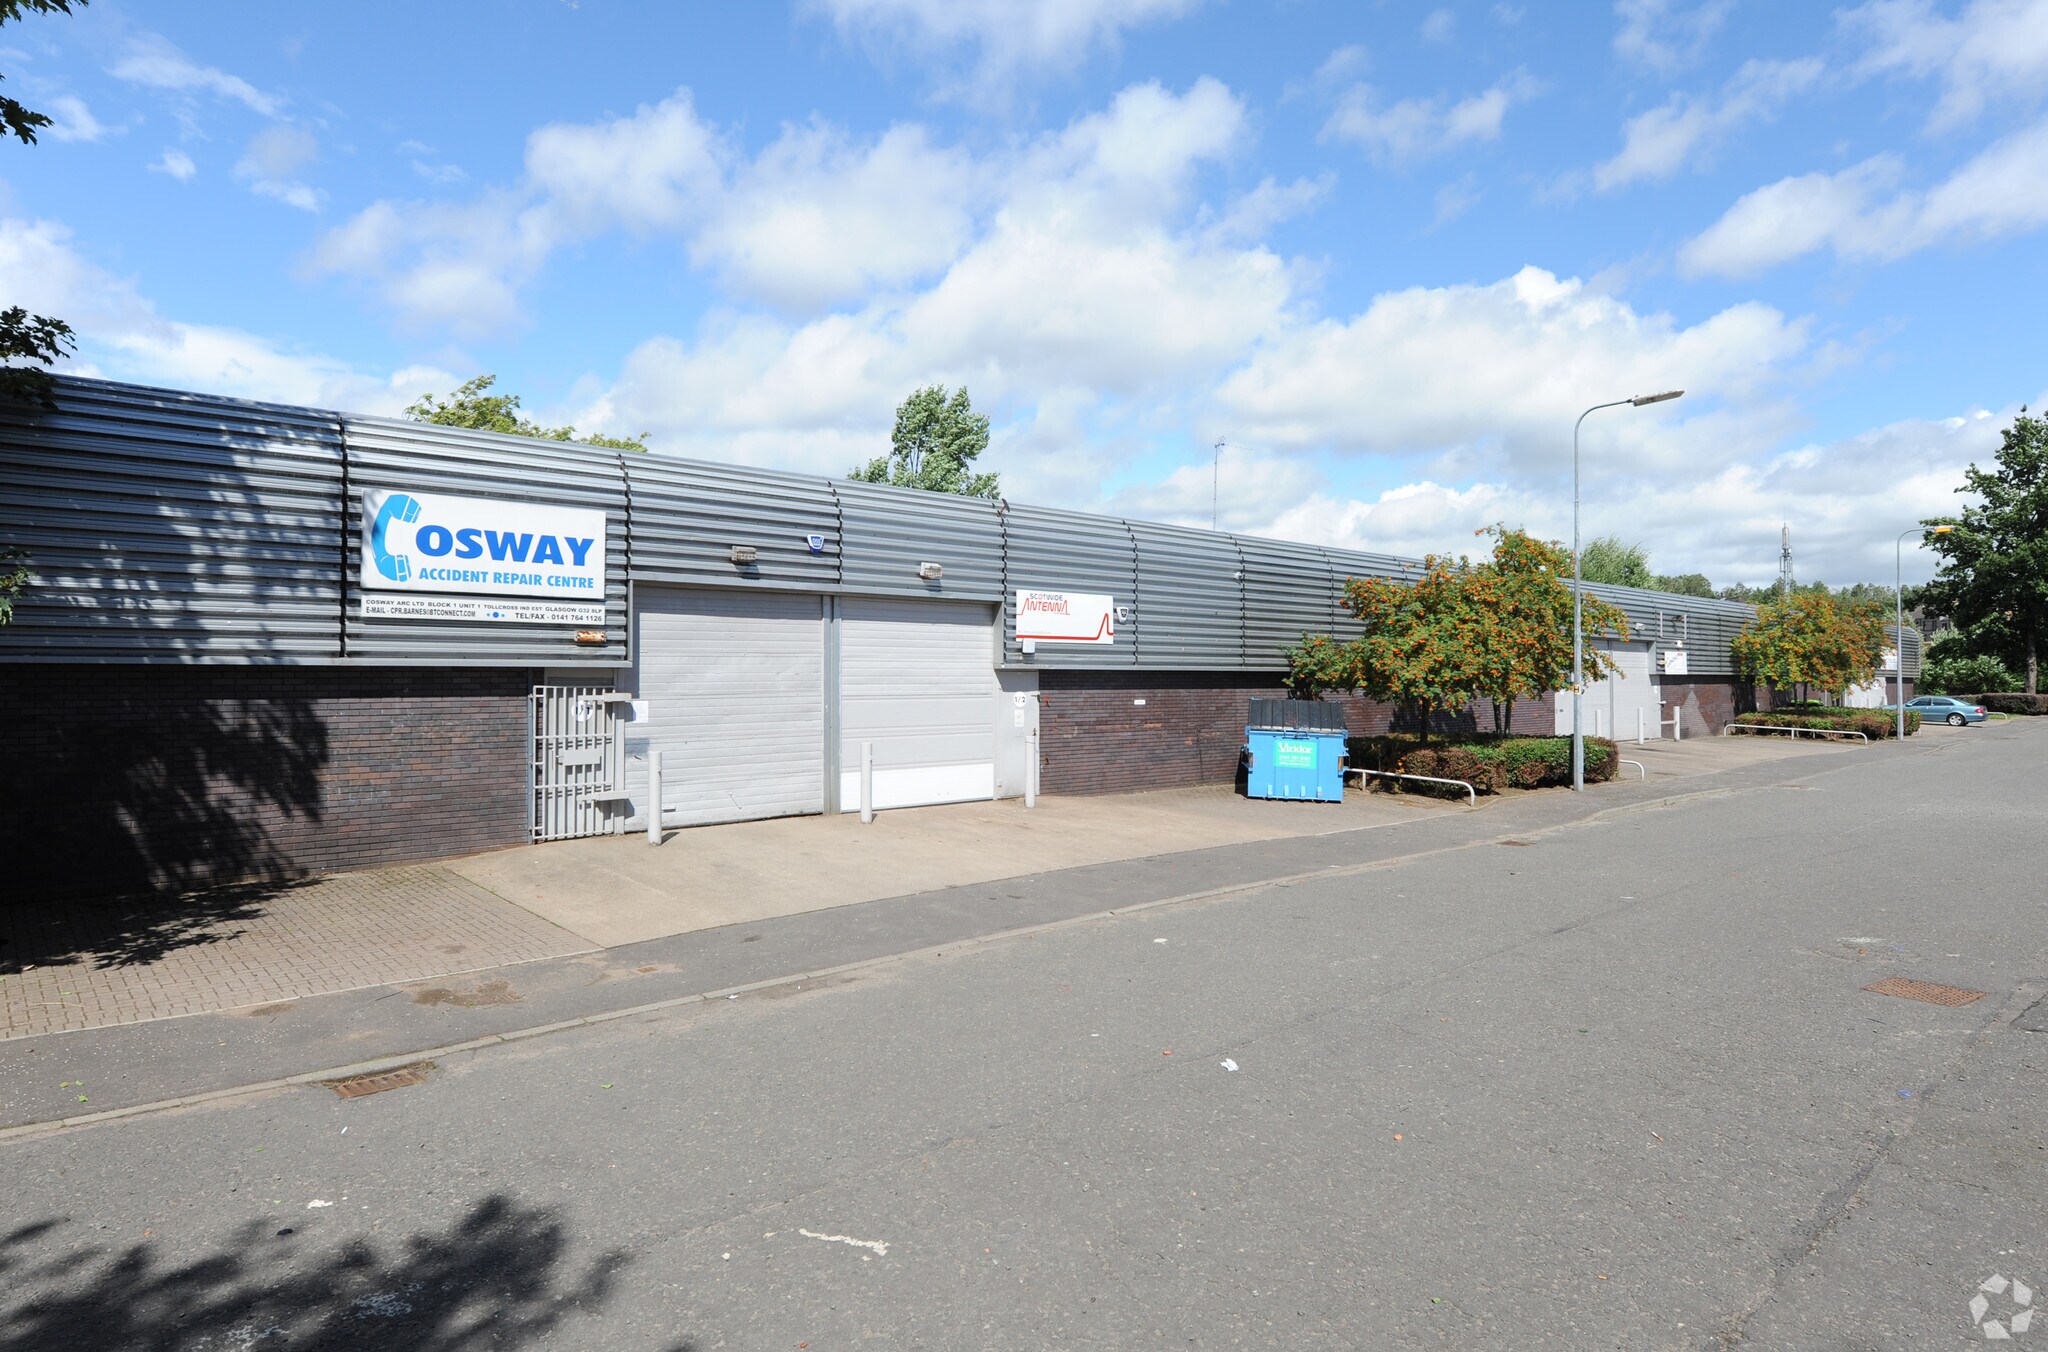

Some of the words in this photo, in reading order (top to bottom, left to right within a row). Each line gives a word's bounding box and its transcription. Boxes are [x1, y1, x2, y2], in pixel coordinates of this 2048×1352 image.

[419, 567, 489, 583] ACCIDENT
[493, 572, 542, 585] REPAIR
[546, 575, 594, 588] CENTRE
[1029, 593, 1063, 601] SCOTWIDE
[365, 606, 386, 614] E-MAIL
[1020, 597, 1069, 615] ANTENNA
[515, 612, 545, 620] TEL/FAX
[551, 613, 569, 621] 0141
